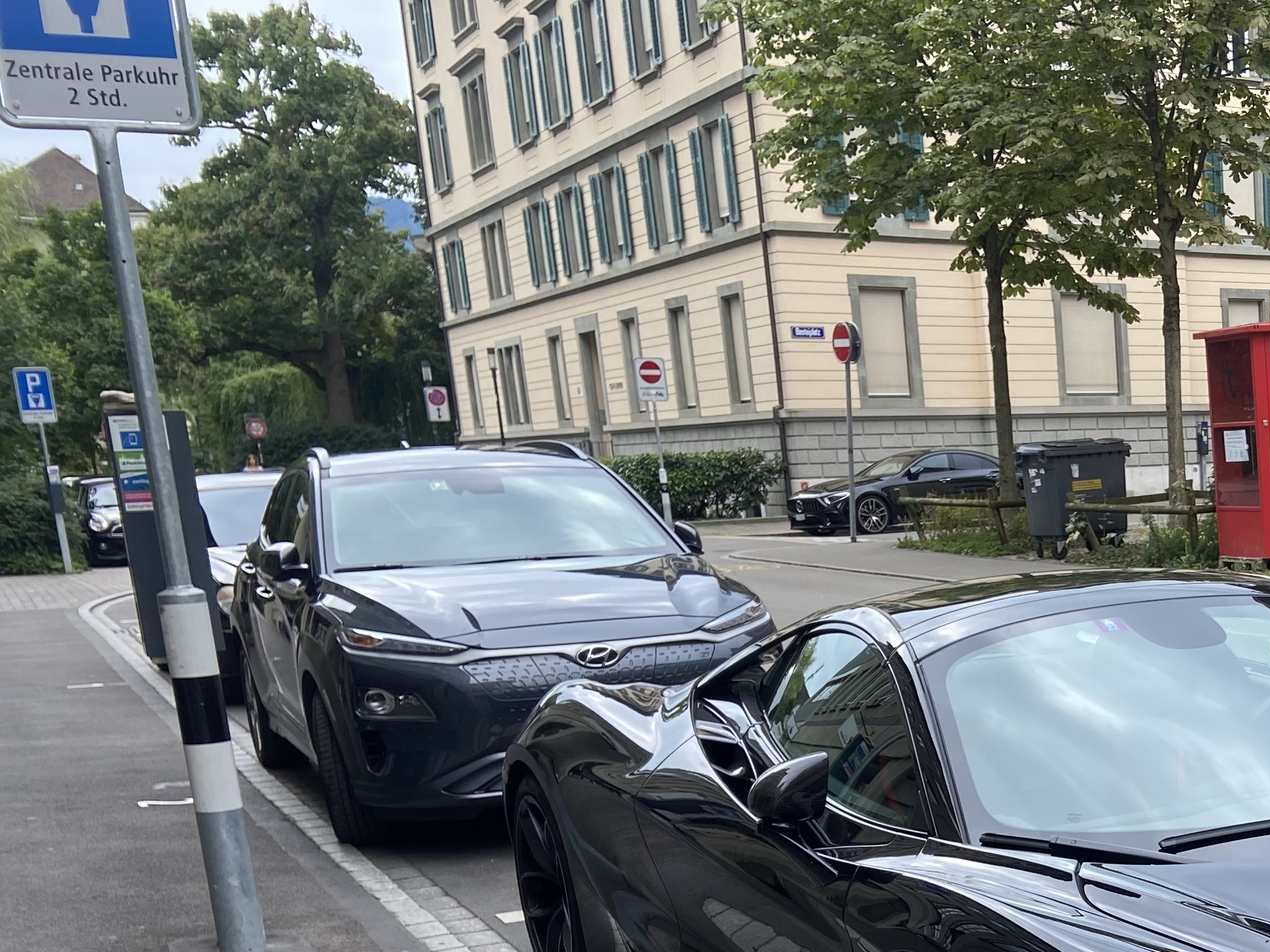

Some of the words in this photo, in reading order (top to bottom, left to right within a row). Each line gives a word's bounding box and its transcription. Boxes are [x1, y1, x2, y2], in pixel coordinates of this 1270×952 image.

[4, 59, 93, 82] Zentrale
[101, 64, 178, 86] Parkuhr
[68, 87, 80, 105] 2
[87, 88, 128, 107] Std.
[25, 373, 41, 393] P
